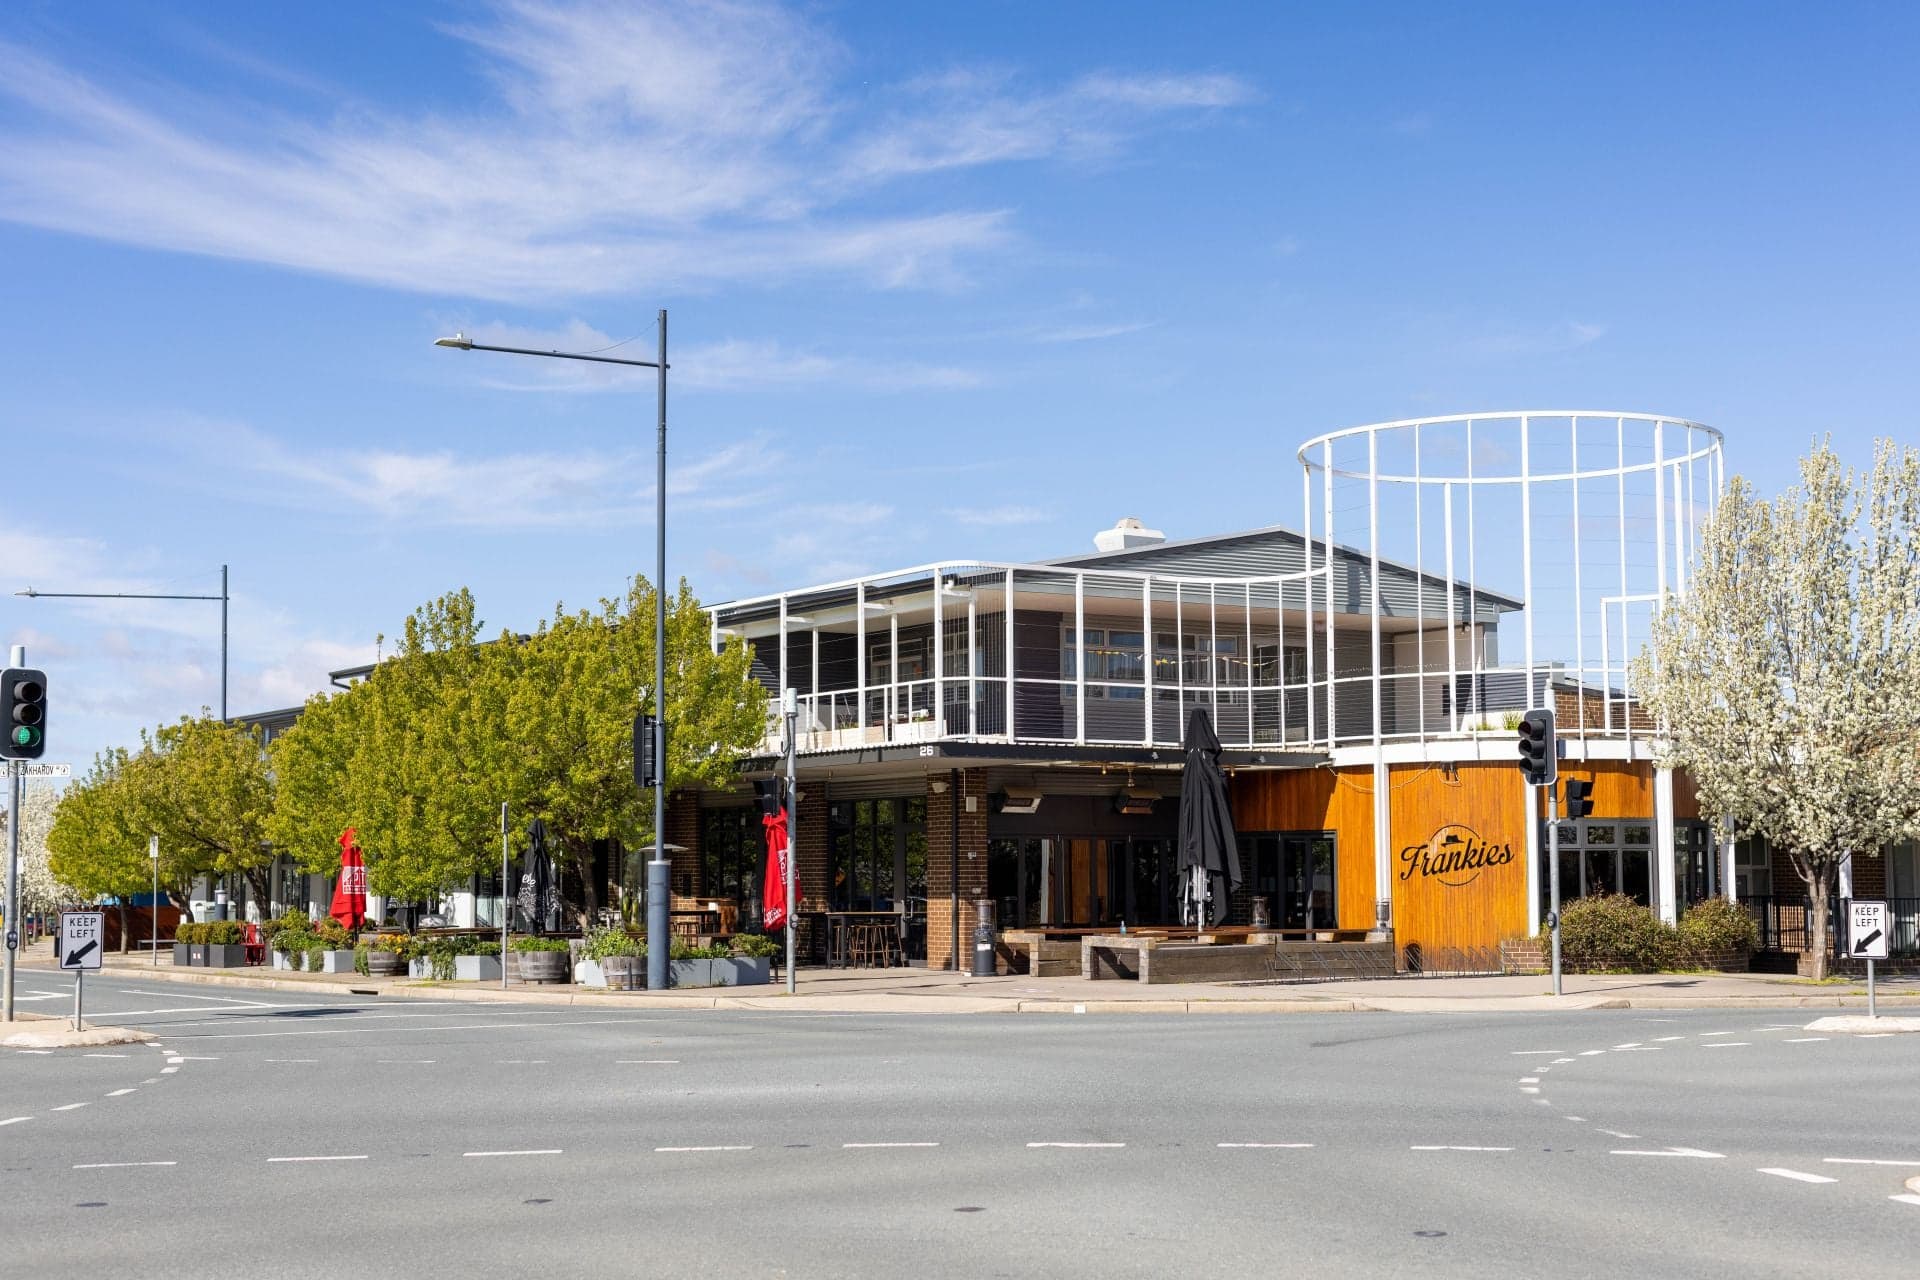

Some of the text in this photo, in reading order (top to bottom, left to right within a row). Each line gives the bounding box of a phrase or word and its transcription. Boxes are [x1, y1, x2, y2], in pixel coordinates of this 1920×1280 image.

[919, 745, 934, 756] 26
[21, 765, 54, 776] ZAKHAROV
[1400, 837, 1515, 880] Frankies
[1855, 907, 1880, 916] KEEP
[69, 917, 97, 927] KEEP
[1855, 918, 1879, 927] LEFT
[70, 929, 96, 938] LEFT
